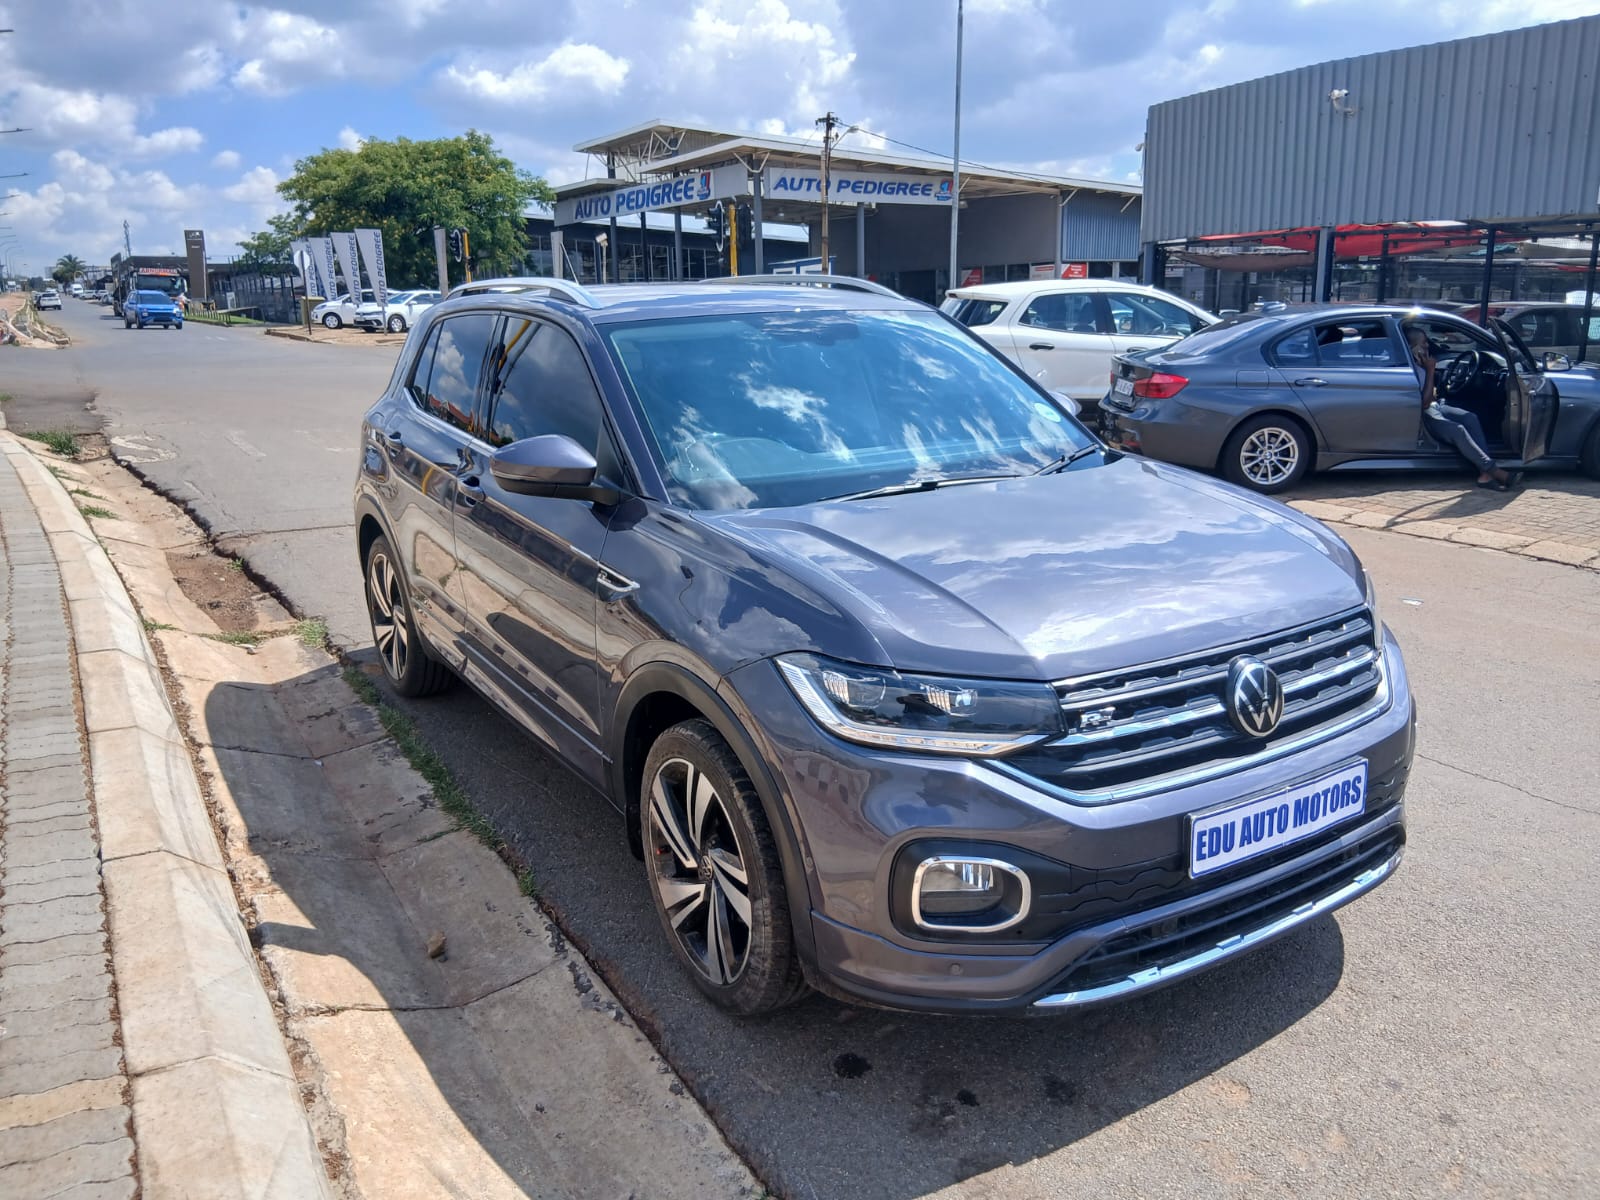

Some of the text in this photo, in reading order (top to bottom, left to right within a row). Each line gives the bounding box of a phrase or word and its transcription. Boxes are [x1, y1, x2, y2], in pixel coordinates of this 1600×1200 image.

[574, 178, 695, 219] AUTO PEDIGREE
[837, 179, 933, 196] PEDIGREE
[324, 239, 335, 279] PEDIGREE
[348, 234, 361, 303] AUTO PEDIGREE
[373, 231, 387, 305] AUTO PEDIGREE
[1196, 775, 1361, 861] EDU AUTO MOTORS
